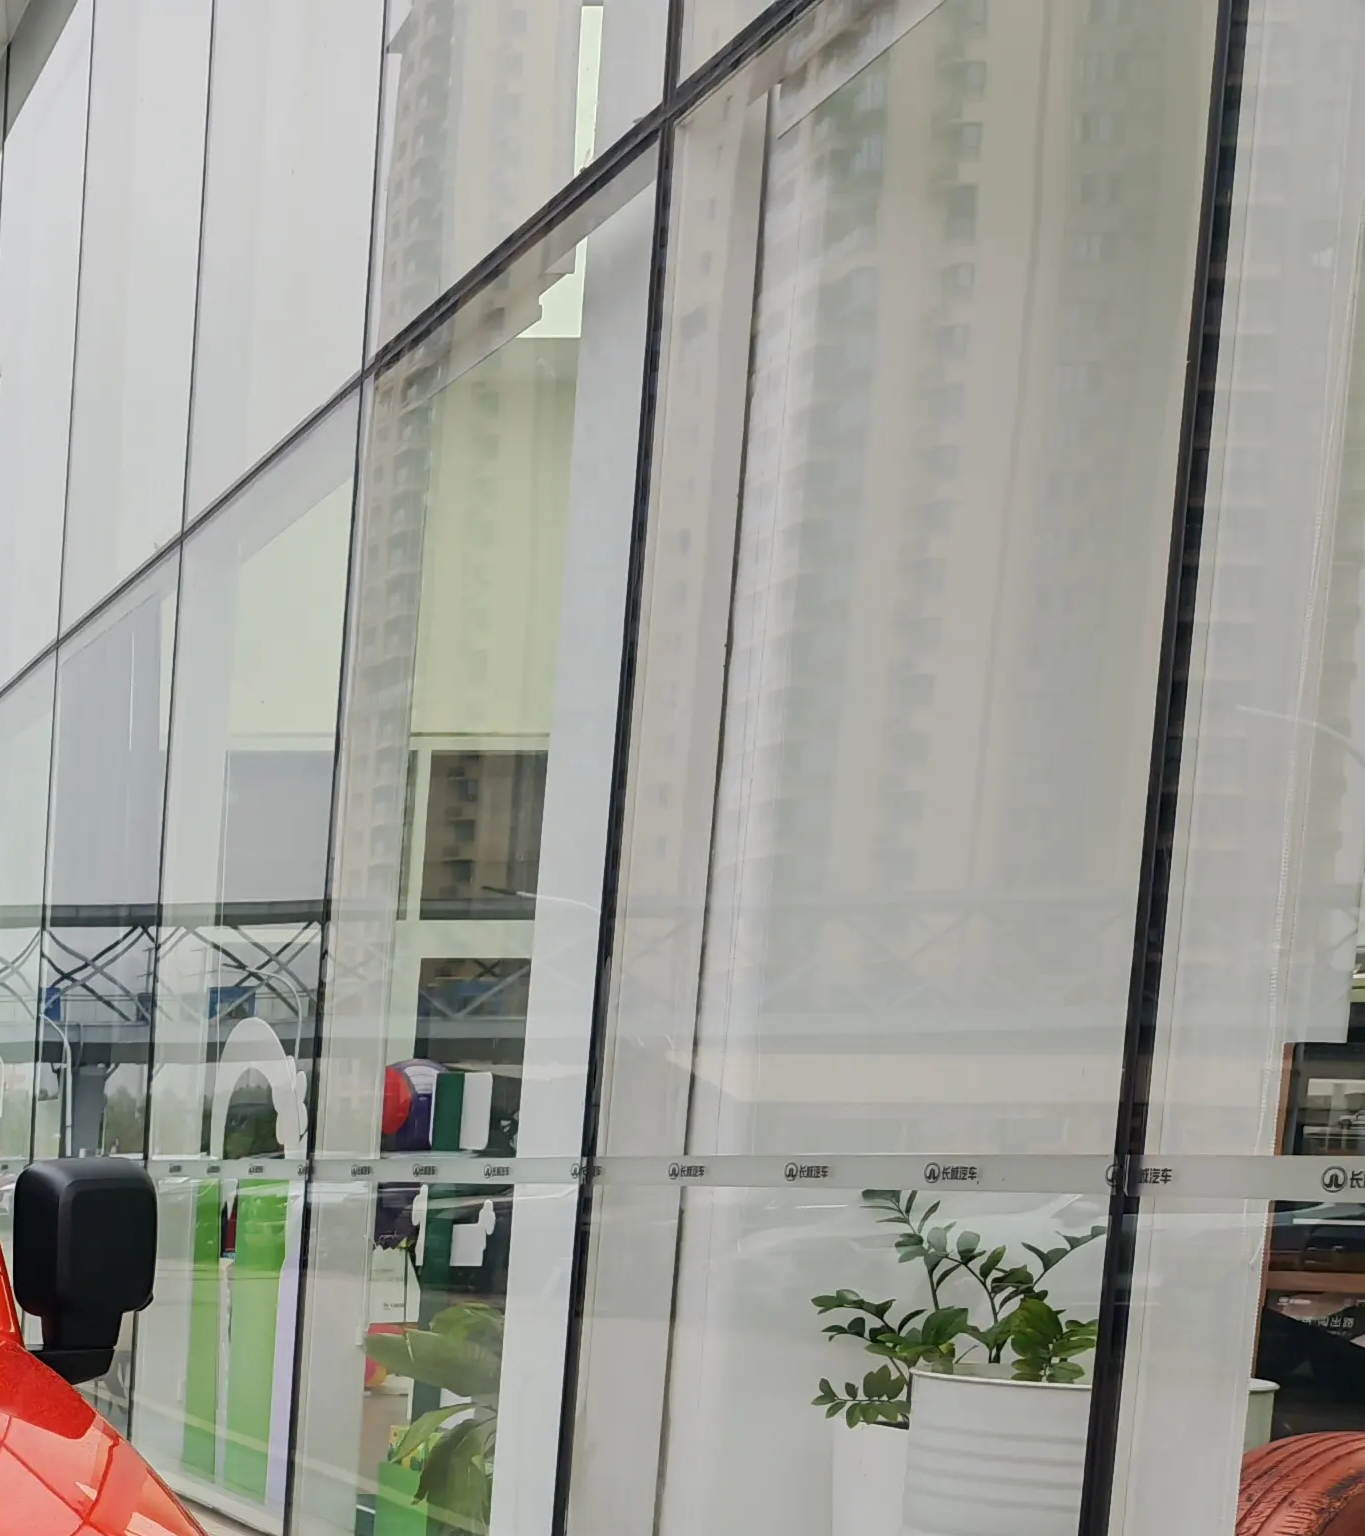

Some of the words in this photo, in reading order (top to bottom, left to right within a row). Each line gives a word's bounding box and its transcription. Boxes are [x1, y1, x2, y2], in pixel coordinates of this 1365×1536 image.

[799, 1165, 829, 1178] 长城汽车
[941, 1165, 977, 1180] 长城汽车
